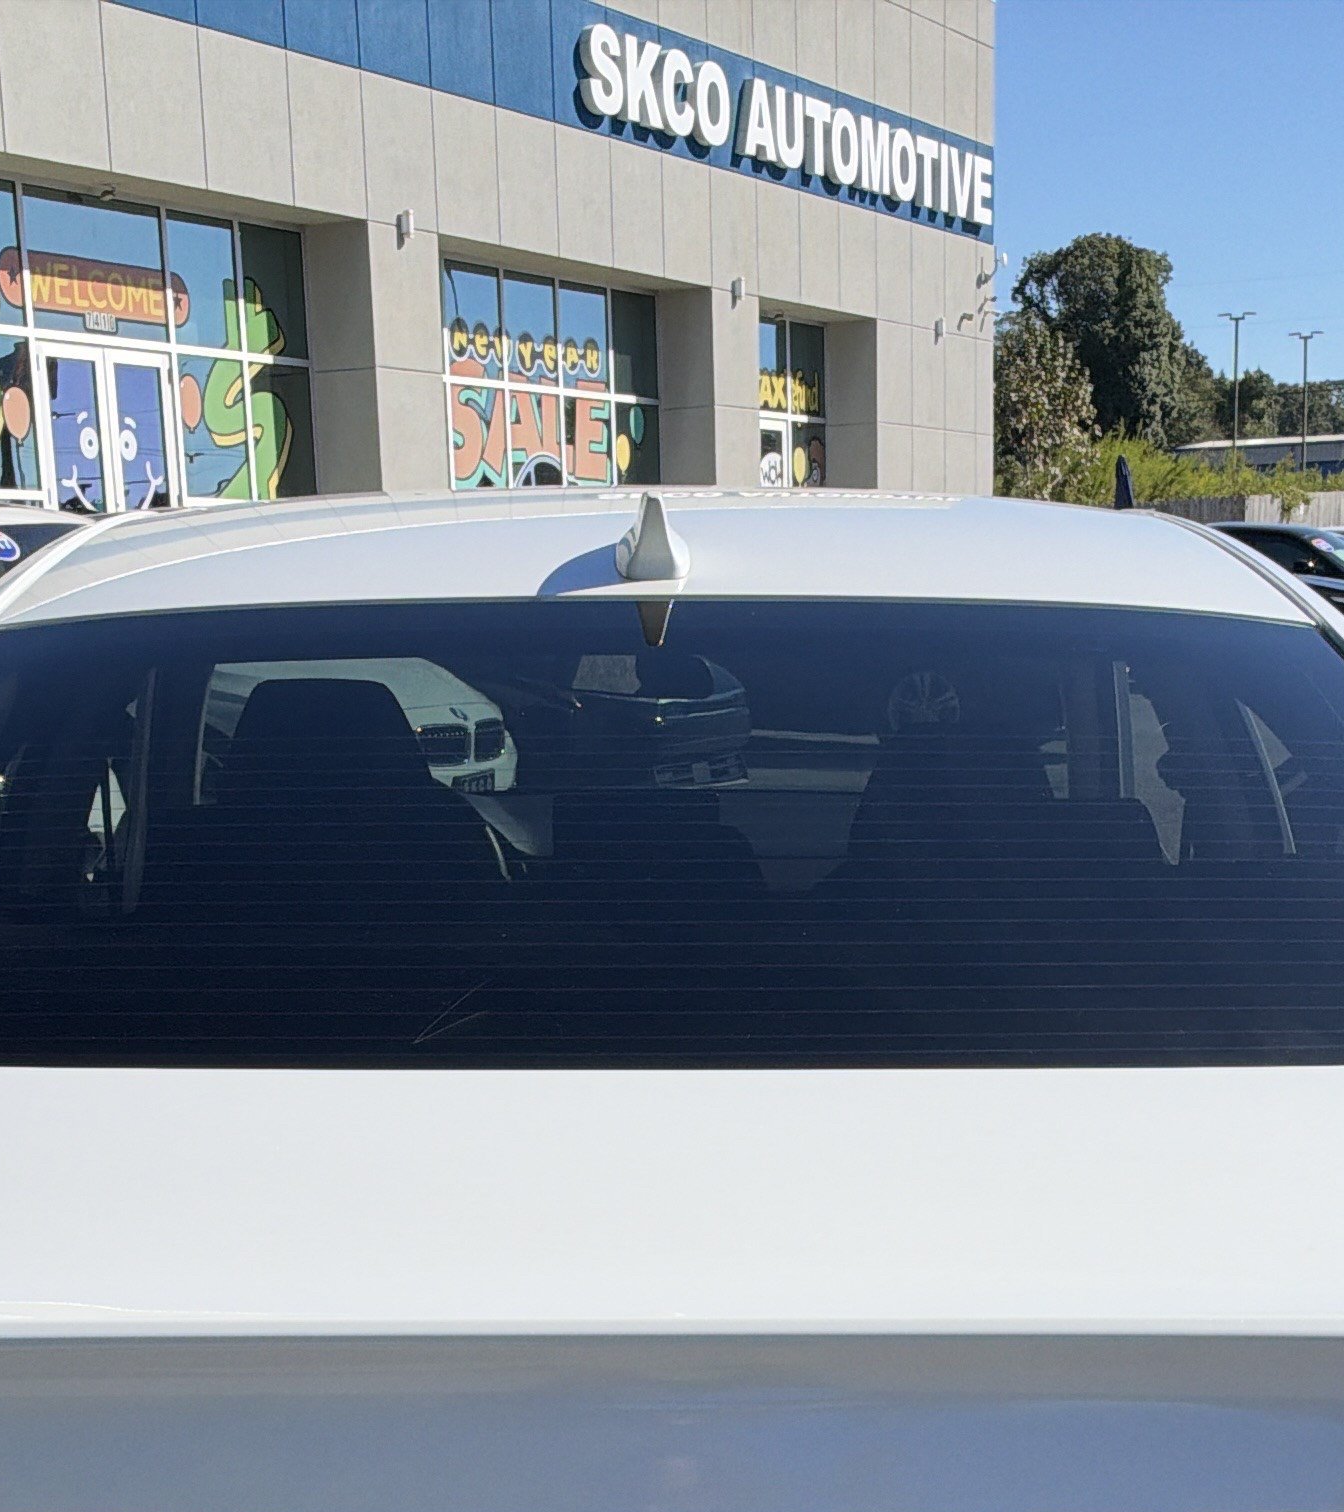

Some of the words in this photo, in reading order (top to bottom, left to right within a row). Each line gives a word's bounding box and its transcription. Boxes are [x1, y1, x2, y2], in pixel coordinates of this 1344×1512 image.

[581, 23, 731, 147] SKCO
[739, 77, 993, 226] AUTOMOTIVE
[31, 261, 165, 317] WELCOME
[450, 359, 610, 486] SALE
